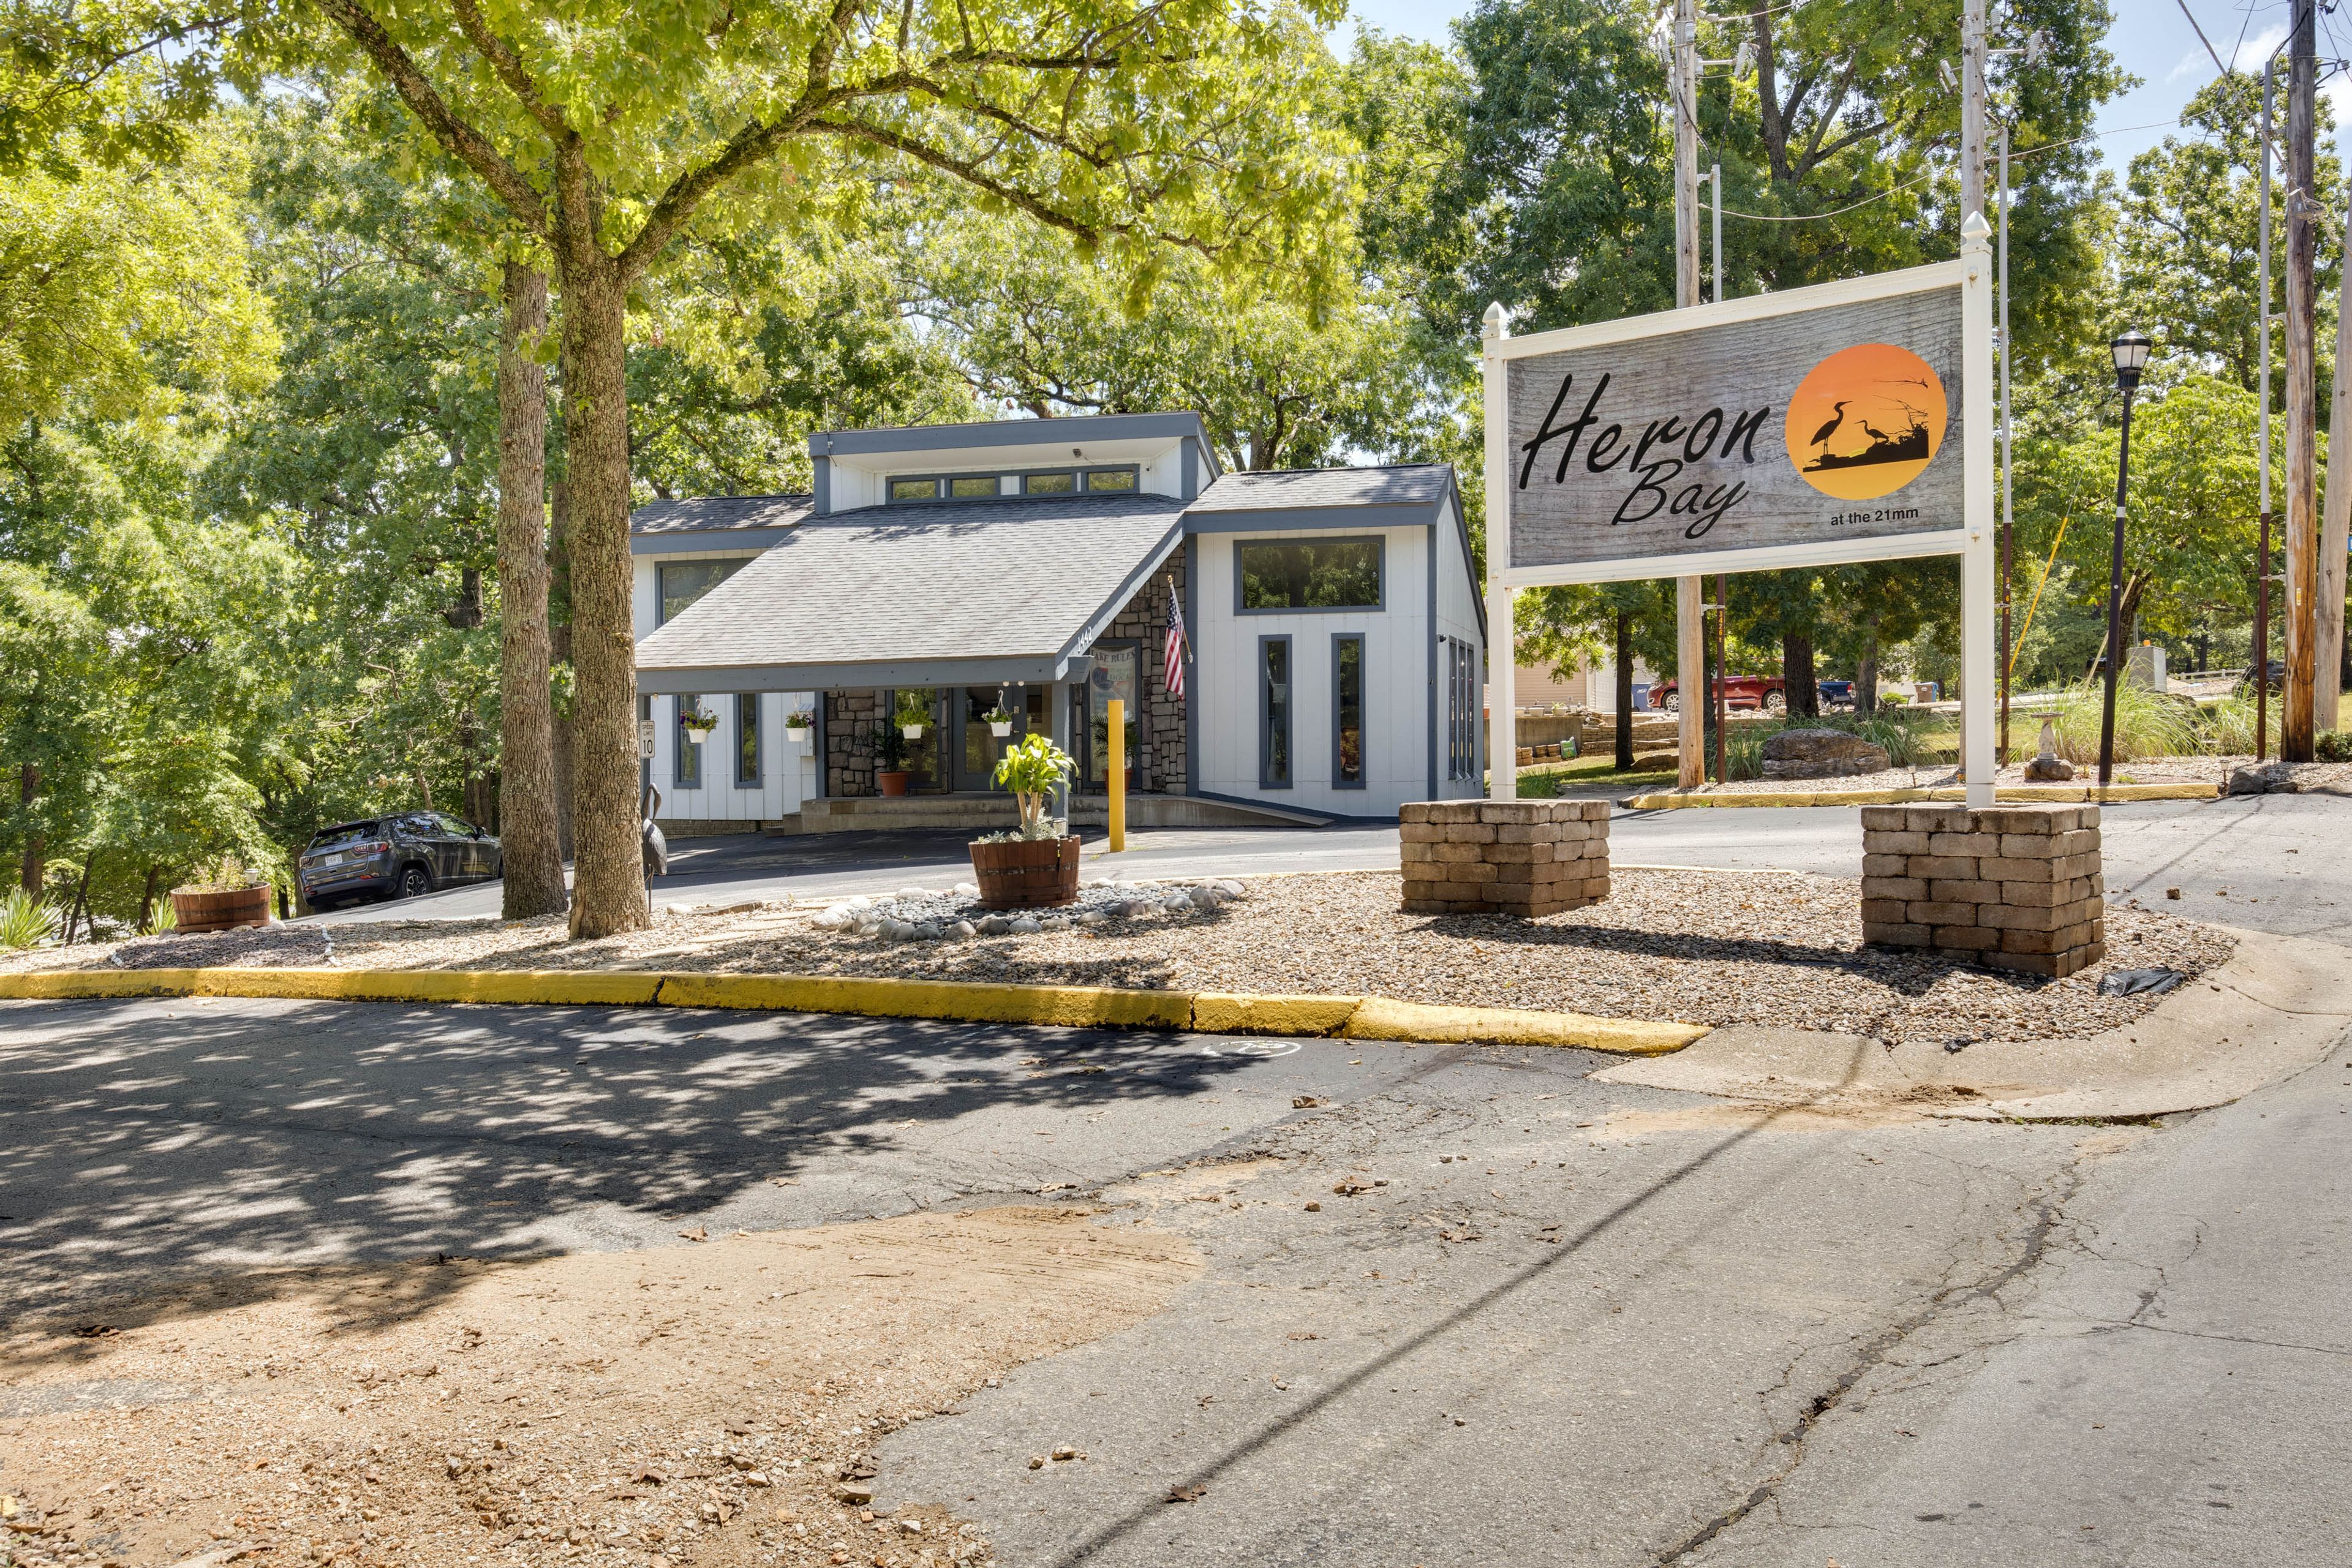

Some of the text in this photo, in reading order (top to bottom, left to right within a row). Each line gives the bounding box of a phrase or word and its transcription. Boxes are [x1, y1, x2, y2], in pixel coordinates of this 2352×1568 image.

[1518, 371, 1771, 490] Heron
[1611, 458, 1750, 540] Bay
[1830, 508, 1919, 526] at the 21mm
[1077, 626, 1092, 652] 1442
[643, 739, 653, 754] 10
